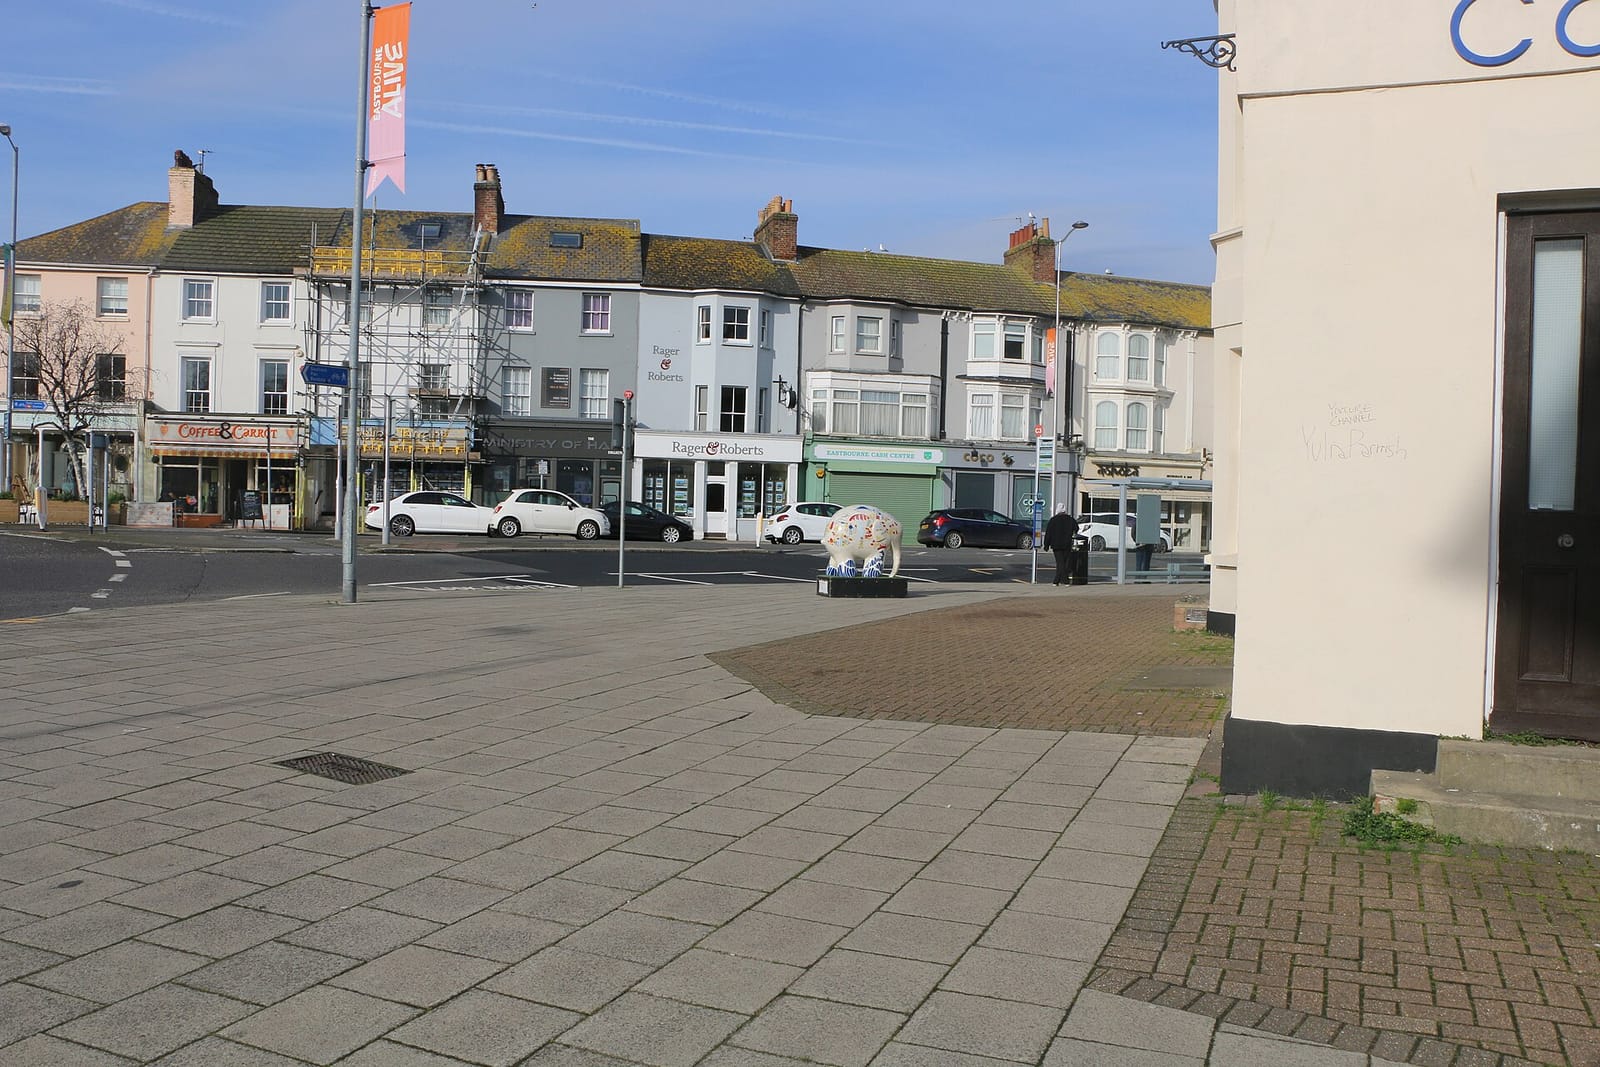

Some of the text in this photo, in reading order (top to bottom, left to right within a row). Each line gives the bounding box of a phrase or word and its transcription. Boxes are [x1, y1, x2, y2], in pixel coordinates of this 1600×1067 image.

[373, 46, 383, 121] EASTBOURNE
[382, 41, 404, 119] ALIVE
[653, 345, 681, 358] Rager
[660, 358, 672, 370] &
[648, 371, 684, 382] Roberts
[482, 438, 557, 449] MINISTRY
[561, 440, 582, 449] OF
[672, 441, 764, 457] Rager & Roberts
[827, 449, 915, 460] EASTBOURNE CASH CENTRE
